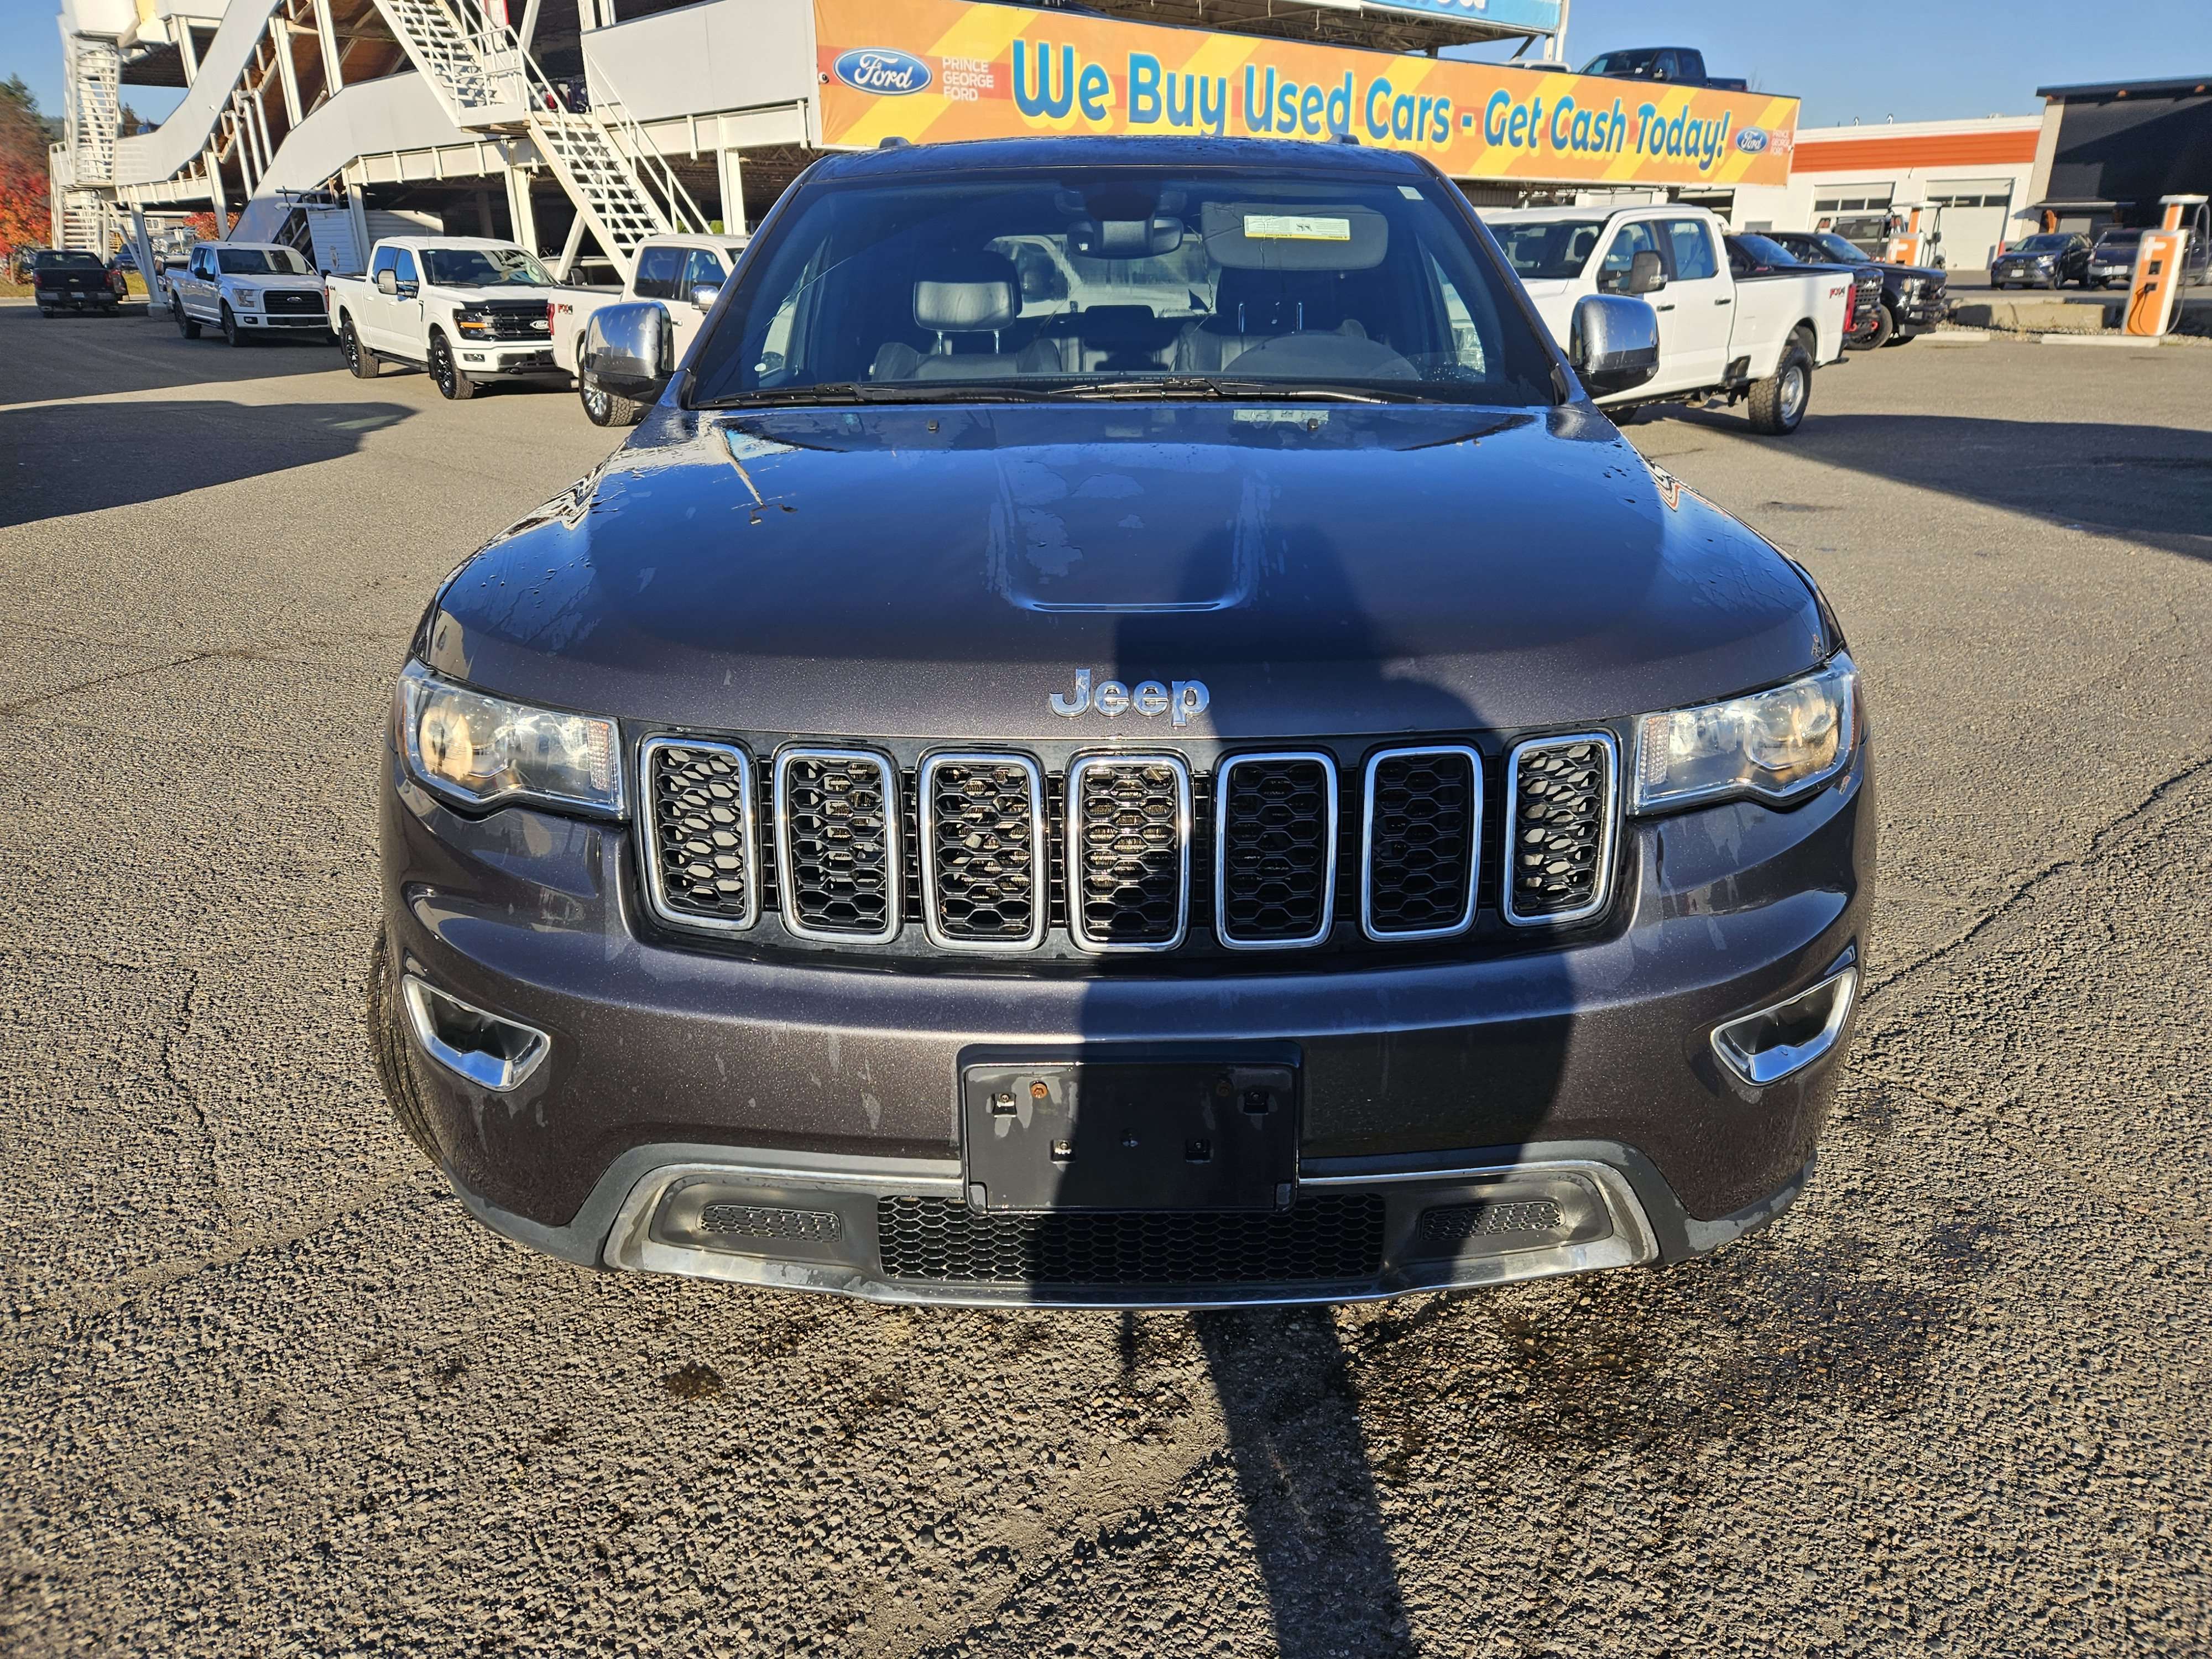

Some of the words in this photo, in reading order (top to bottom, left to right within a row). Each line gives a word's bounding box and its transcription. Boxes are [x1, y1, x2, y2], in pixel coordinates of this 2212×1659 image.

[854, 54, 913, 88] Ford
[942, 56, 989, 72] PRINCE
[943, 70, 994, 88] GEORGE
[943, 86, 979, 101] FORD
[1012, 40, 1109, 121] We
[1129, 53, 1227, 136] Buy
[1245, 65, 1353, 135] Used
[1365, 77, 1451, 143] Cars
[1484, 89, 1542, 148] Get
[1551, 95, 1626, 153] Cash
[1636, 103, 1731, 170] Today!
[1741, 130, 1764, 150] Ford
[1050, 668, 1210, 727] Jeep
